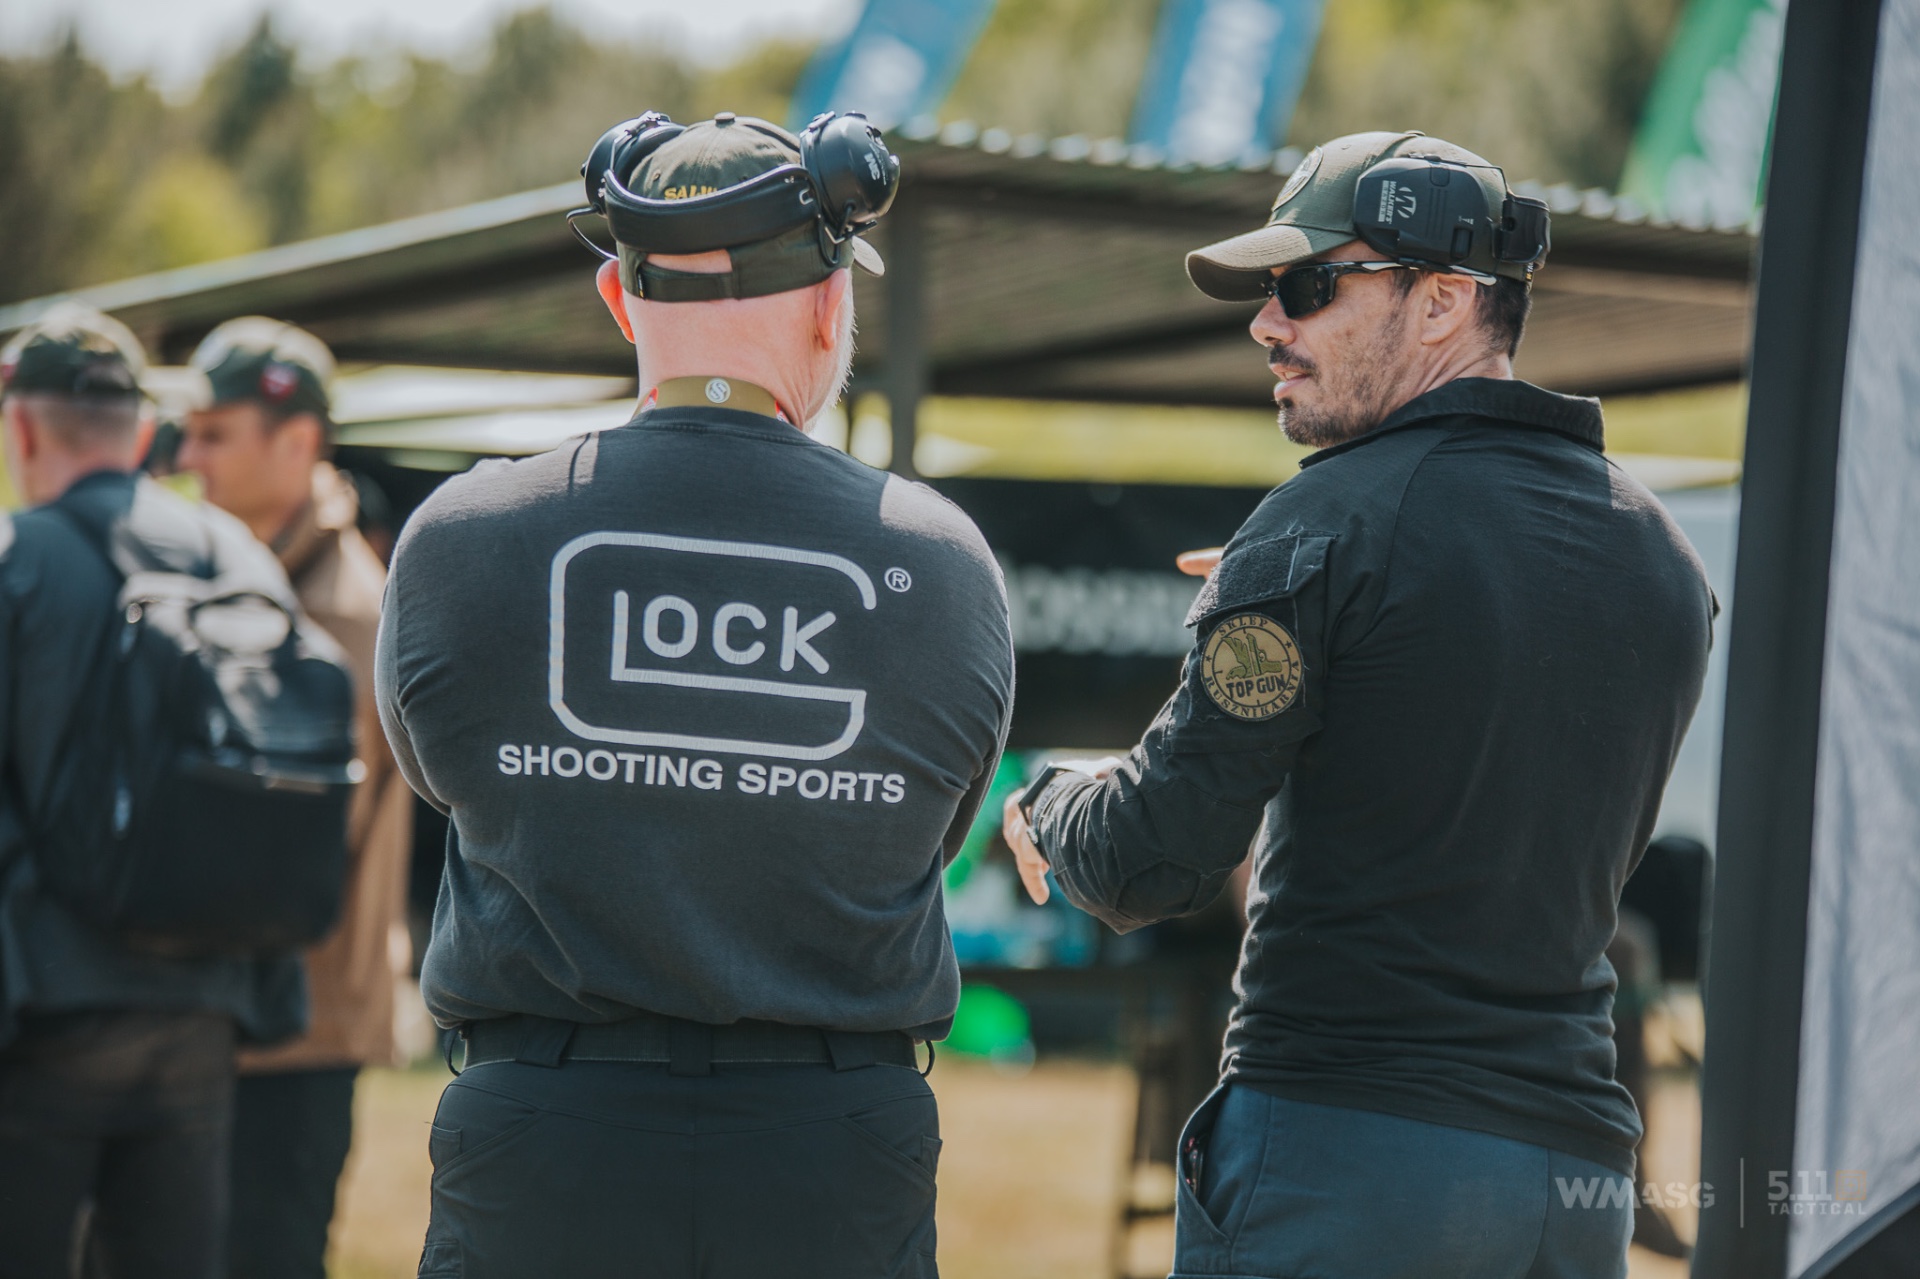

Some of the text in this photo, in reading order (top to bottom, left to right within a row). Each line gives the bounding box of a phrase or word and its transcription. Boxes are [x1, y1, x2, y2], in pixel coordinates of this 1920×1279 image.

[549, 531, 877, 761] GLOCK
[1218, 615, 1269, 637] SKLEP
[1204, 660, 1300, 718] RUSZNIKARNIA
[1226, 674, 1288, 699] TOP GUN
[498, 744, 906, 804] SHOOTING SPORTS
